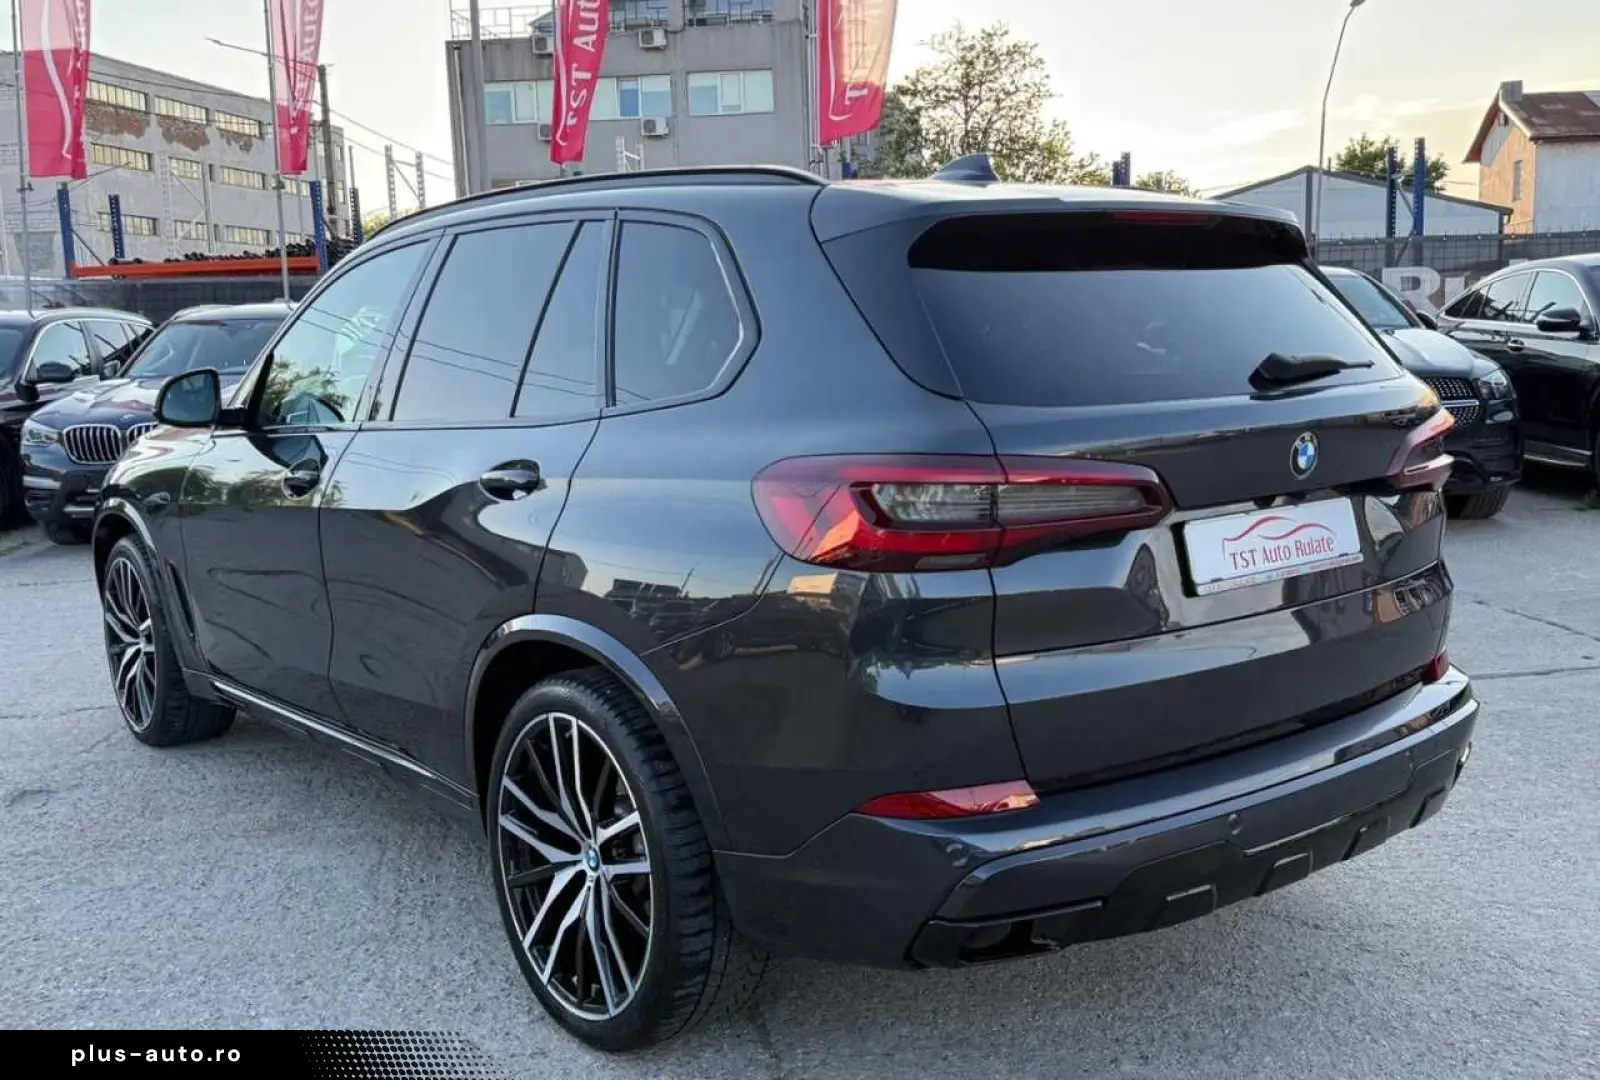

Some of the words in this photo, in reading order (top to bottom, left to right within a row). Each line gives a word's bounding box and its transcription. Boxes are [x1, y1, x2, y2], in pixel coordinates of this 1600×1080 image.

[1229, 548, 1256, 571] TST
[1262, 545, 1291, 565] Auto
[1294, 536, 1335, 558] Rulate
